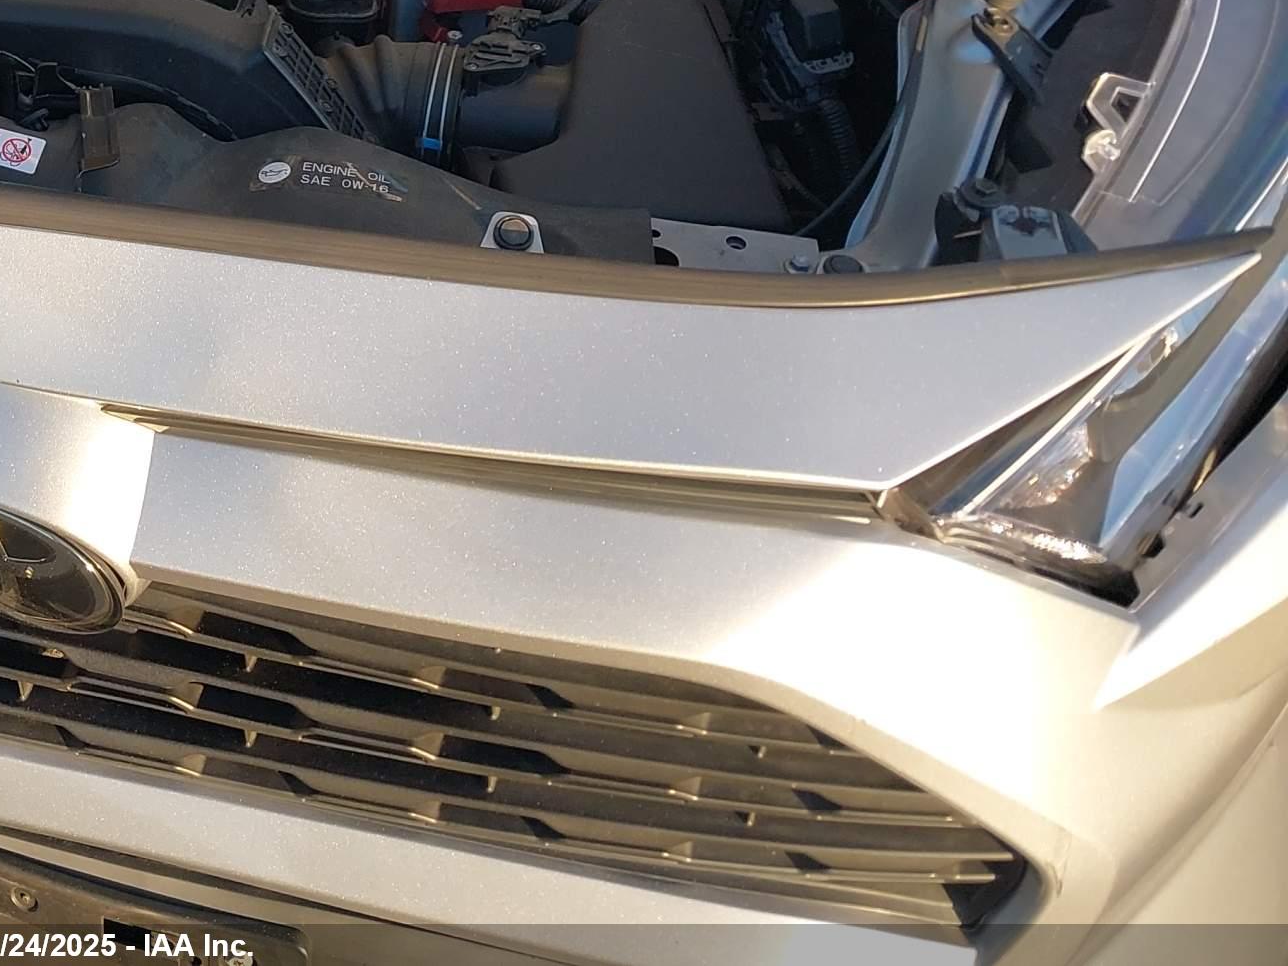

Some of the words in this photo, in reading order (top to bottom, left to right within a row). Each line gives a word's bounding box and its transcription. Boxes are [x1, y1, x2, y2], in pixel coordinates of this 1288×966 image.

[300, 173, 332, 187] SAE
[302, 161, 358, 178] ENGINE
[367, 172, 391, 184] OIL
